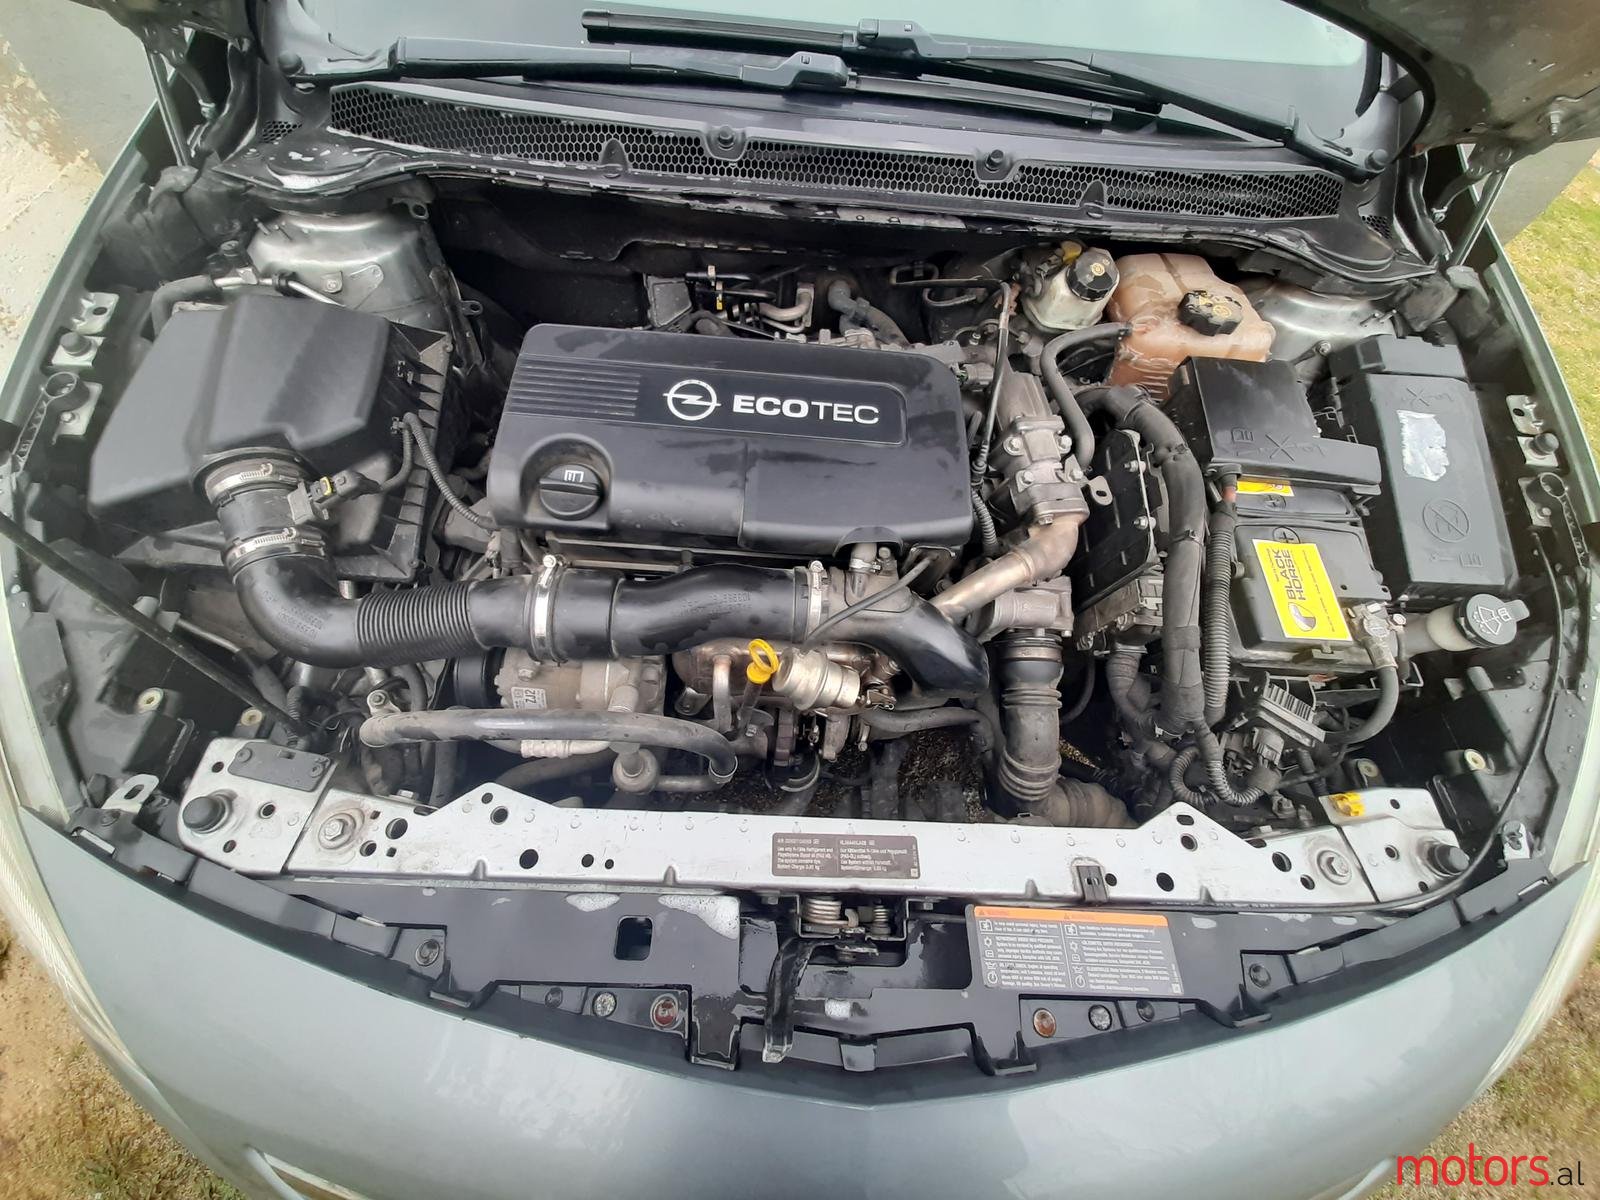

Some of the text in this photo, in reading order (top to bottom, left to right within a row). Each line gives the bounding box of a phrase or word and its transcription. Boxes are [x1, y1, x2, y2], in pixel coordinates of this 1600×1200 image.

[732, 394, 880, 425] ECOTEC
[1272, 548, 1297, 600] BLACK
[1281, 549, 1307, 601] HORSE
